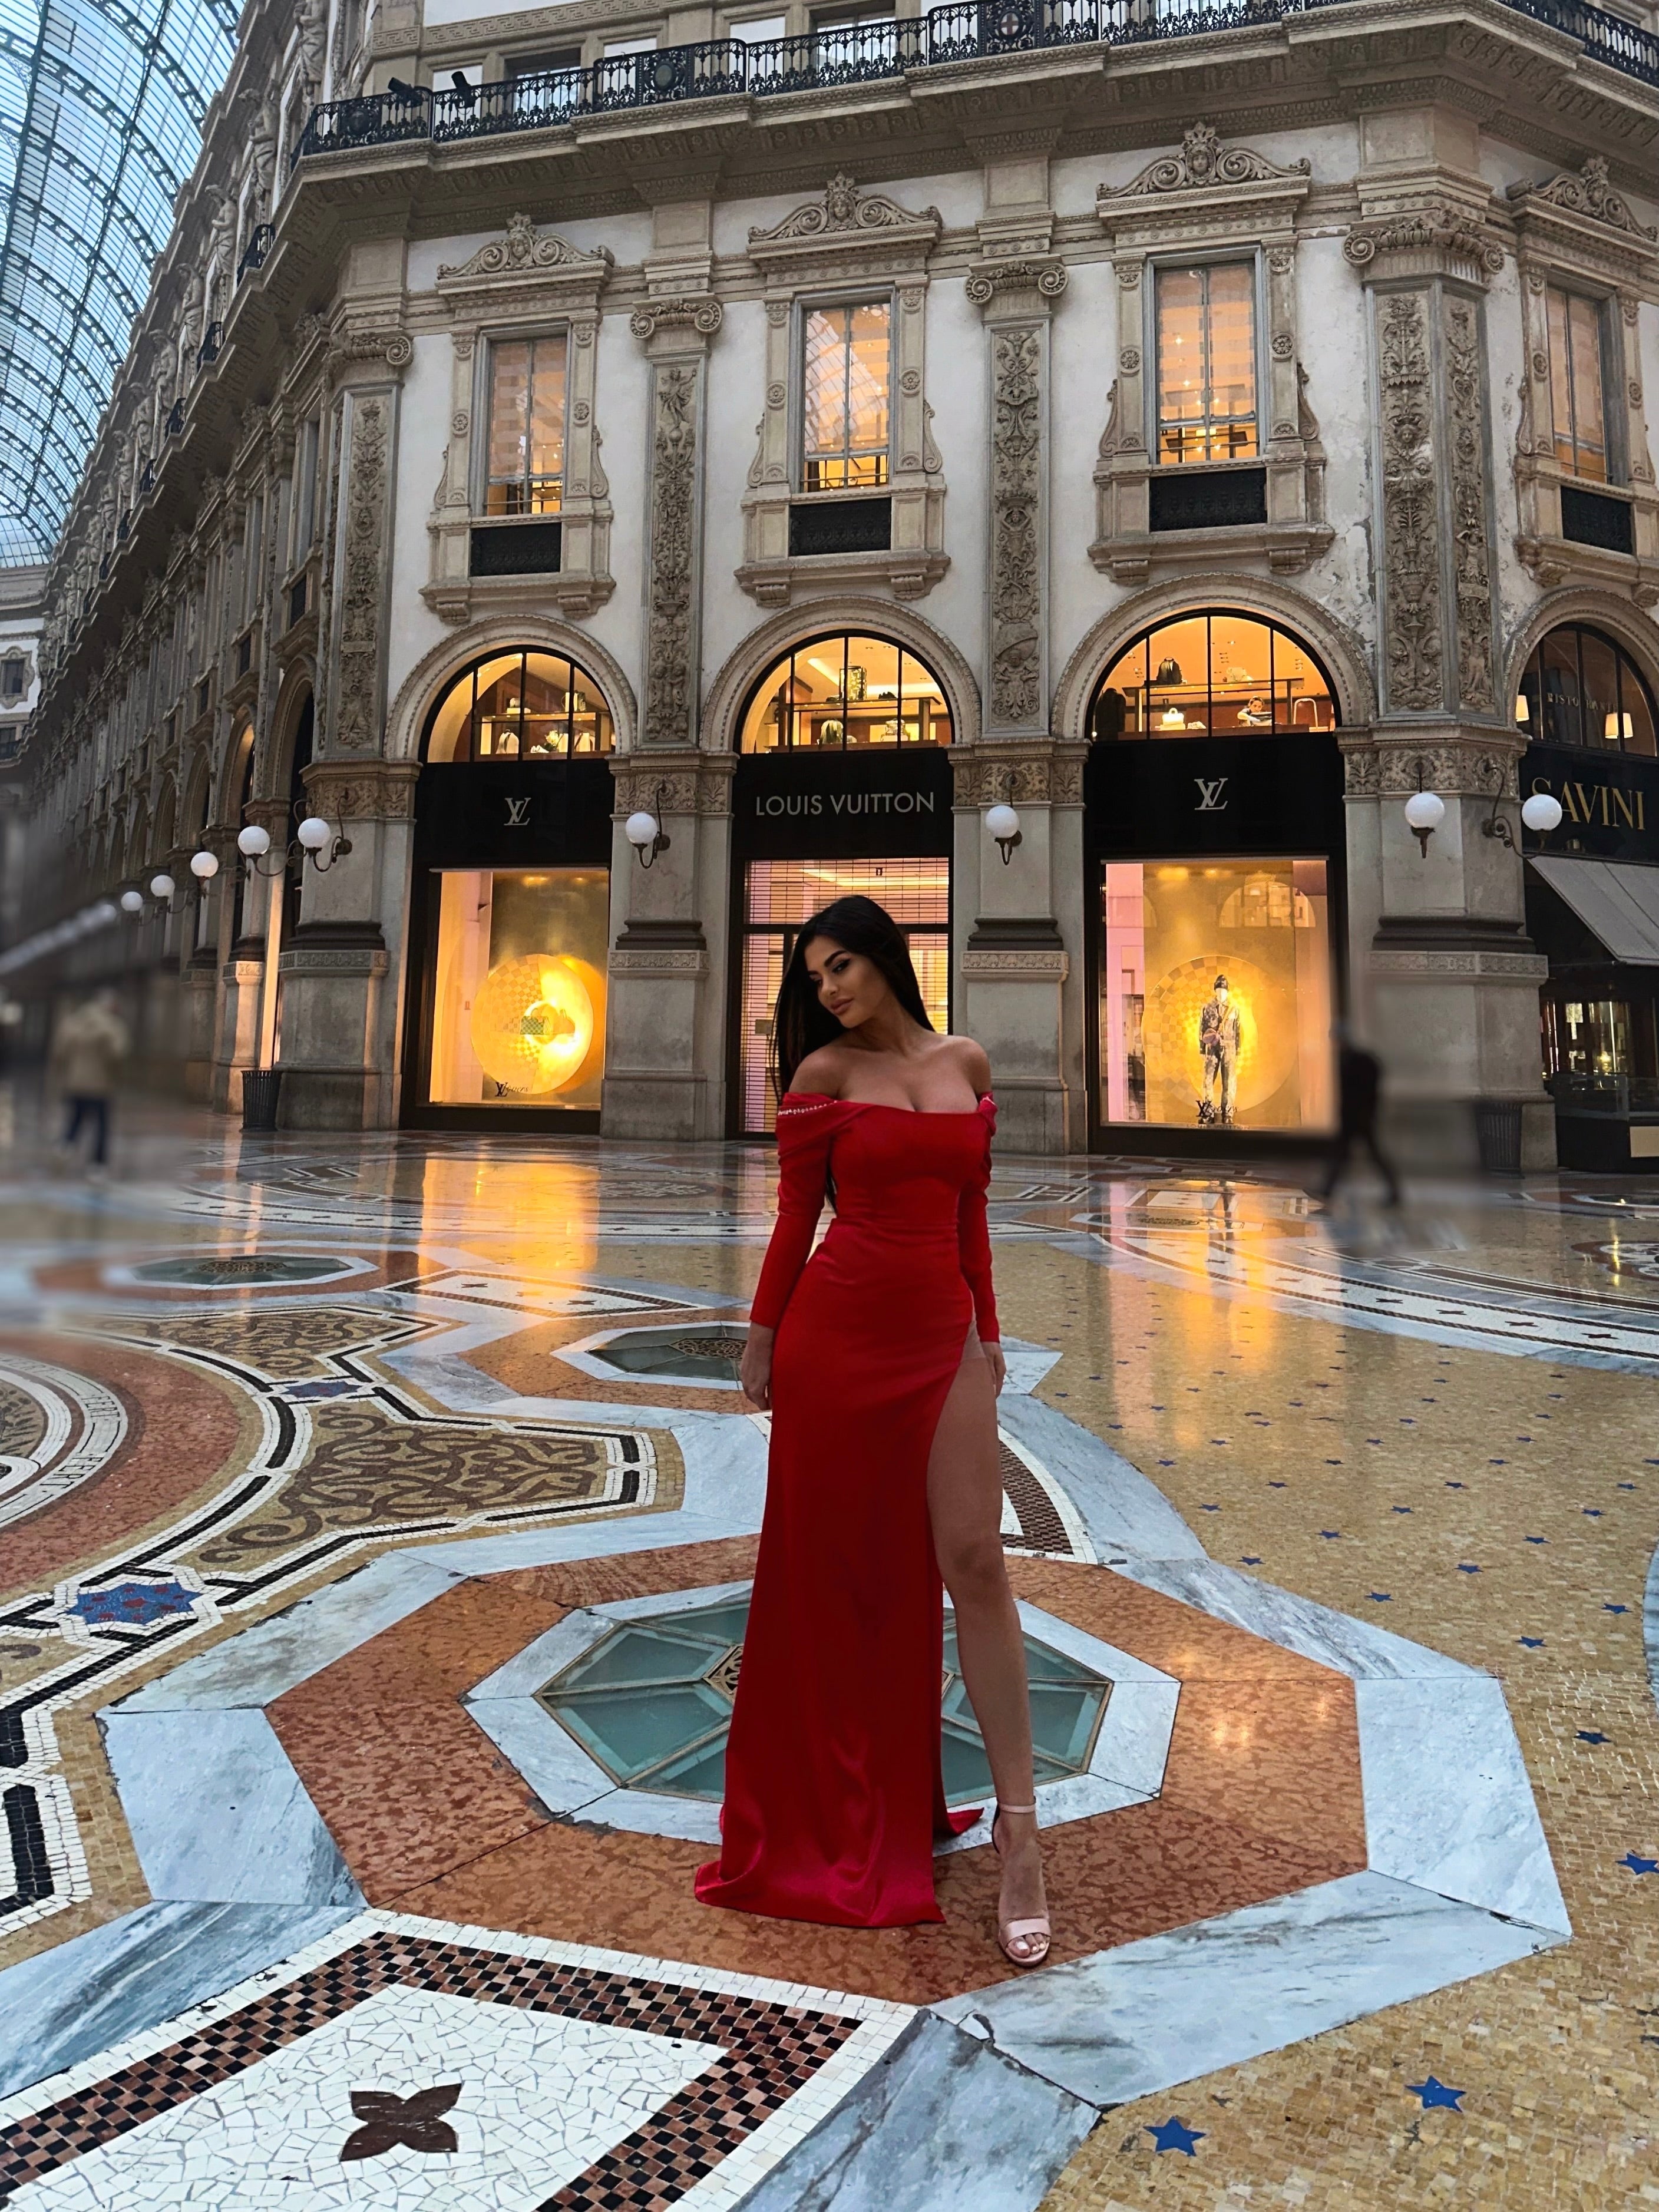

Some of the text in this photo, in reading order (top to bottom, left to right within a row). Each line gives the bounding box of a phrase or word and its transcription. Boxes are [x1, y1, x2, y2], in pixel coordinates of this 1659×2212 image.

[756, 792, 934, 816] LOUIS VUITTON
[1194, 778, 1228, 811] LV
[504, 797, 531, 826] LV
